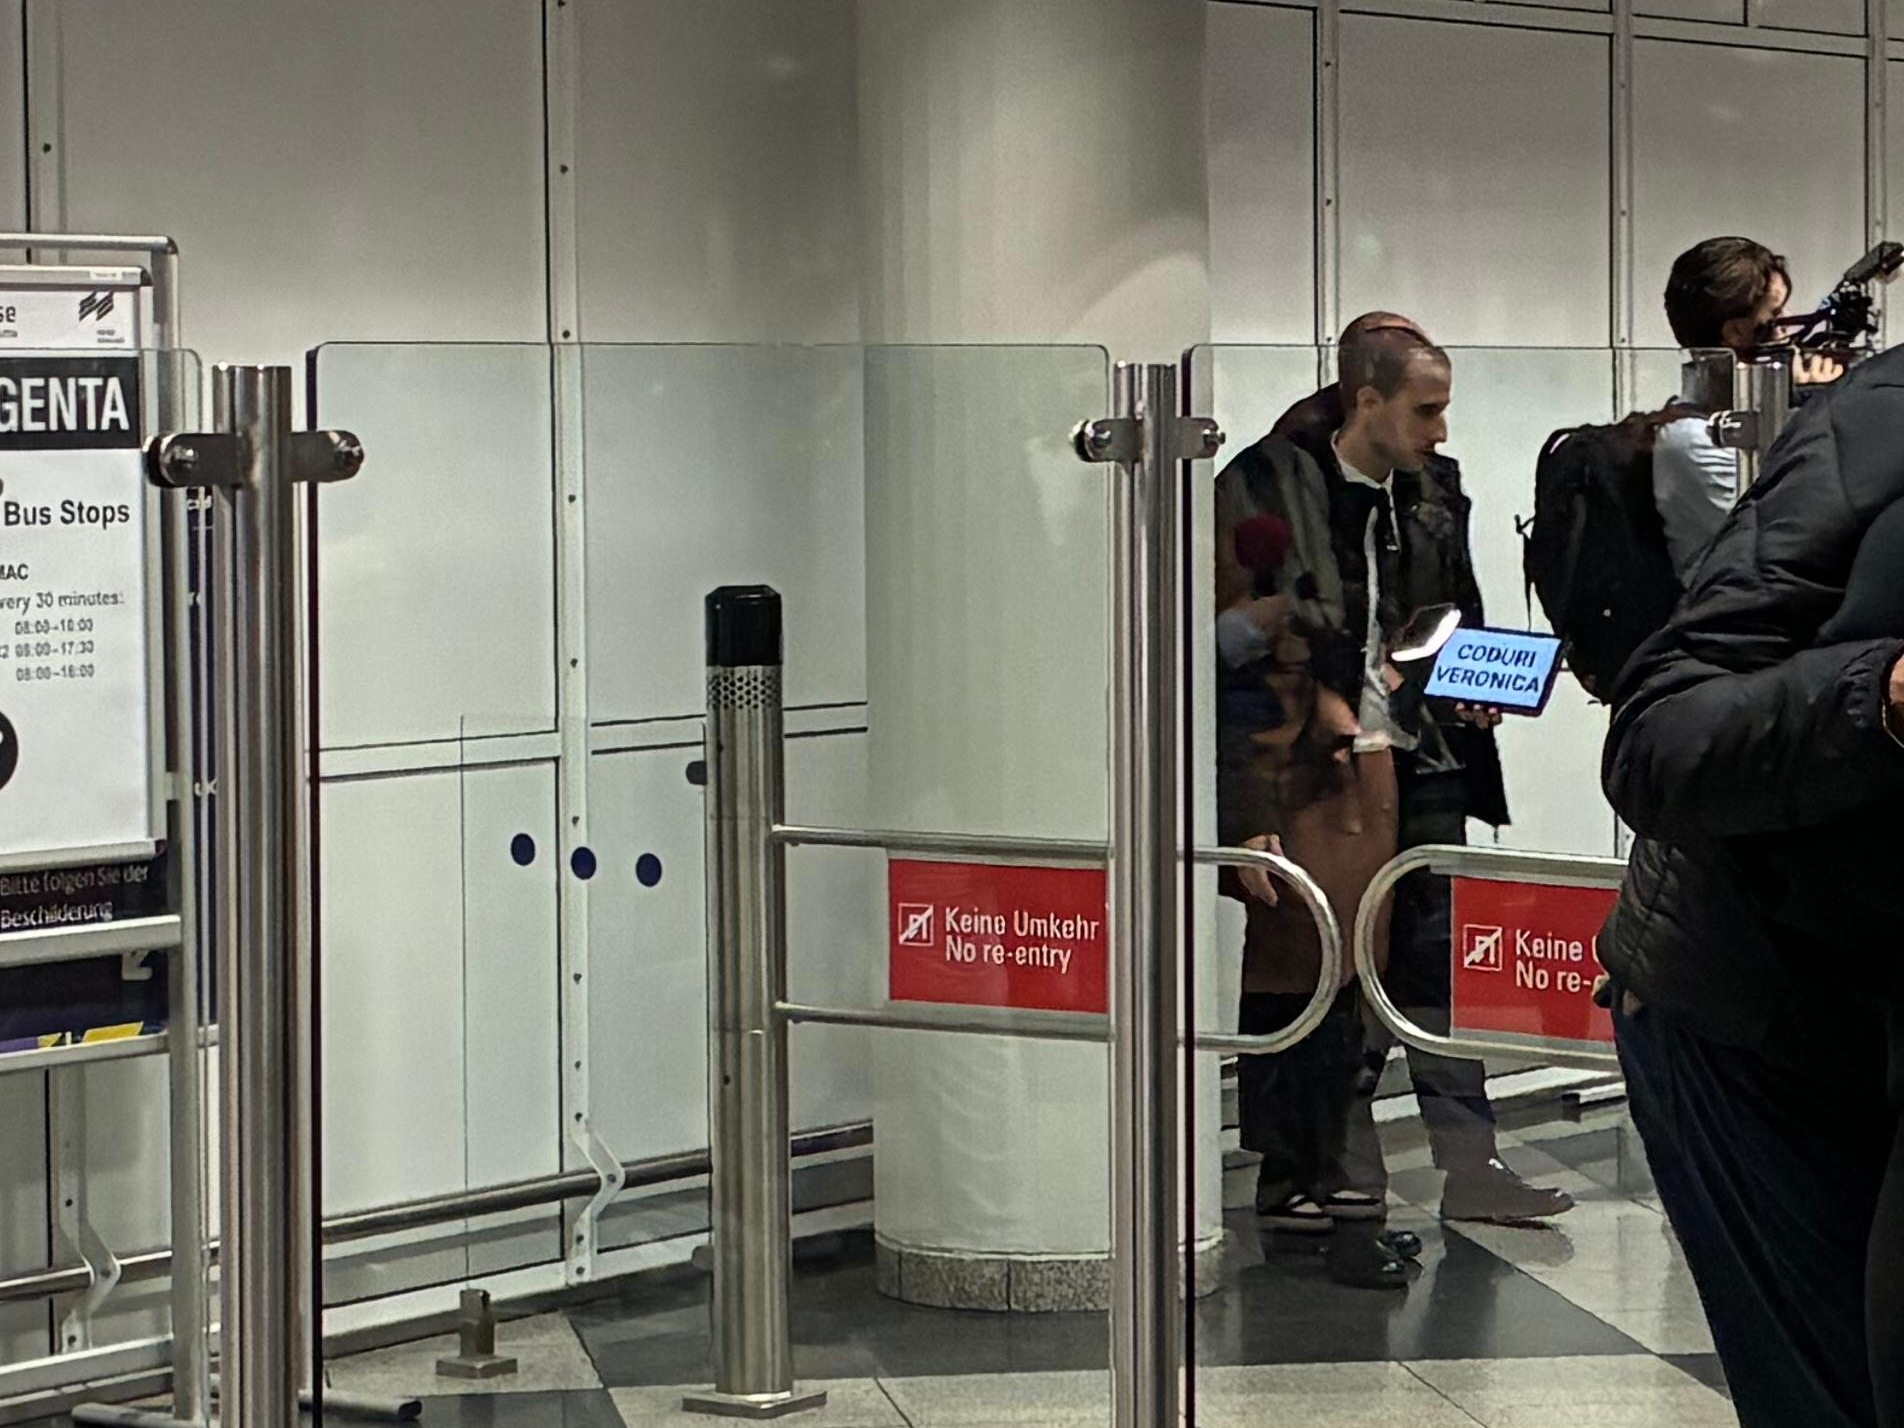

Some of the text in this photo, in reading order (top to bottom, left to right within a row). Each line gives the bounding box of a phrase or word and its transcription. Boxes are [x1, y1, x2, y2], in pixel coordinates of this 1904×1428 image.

[3, 500, 52, 527] Bus
[59, 498, 131, 530] Stops
[35, 591, 54, 608] 30
[1435, 665, 1540, 693] VERONICA
[0, 875, 40, 896] Bitte
[43, 872, 96, 895] folgen
[945, 907, 1100, 941] Keine Umkehr
[945, 935, 1073, 975] No re-entry
[1515, 928, 1584, 962] Keine
[1515, 959, 1550, 990] No
